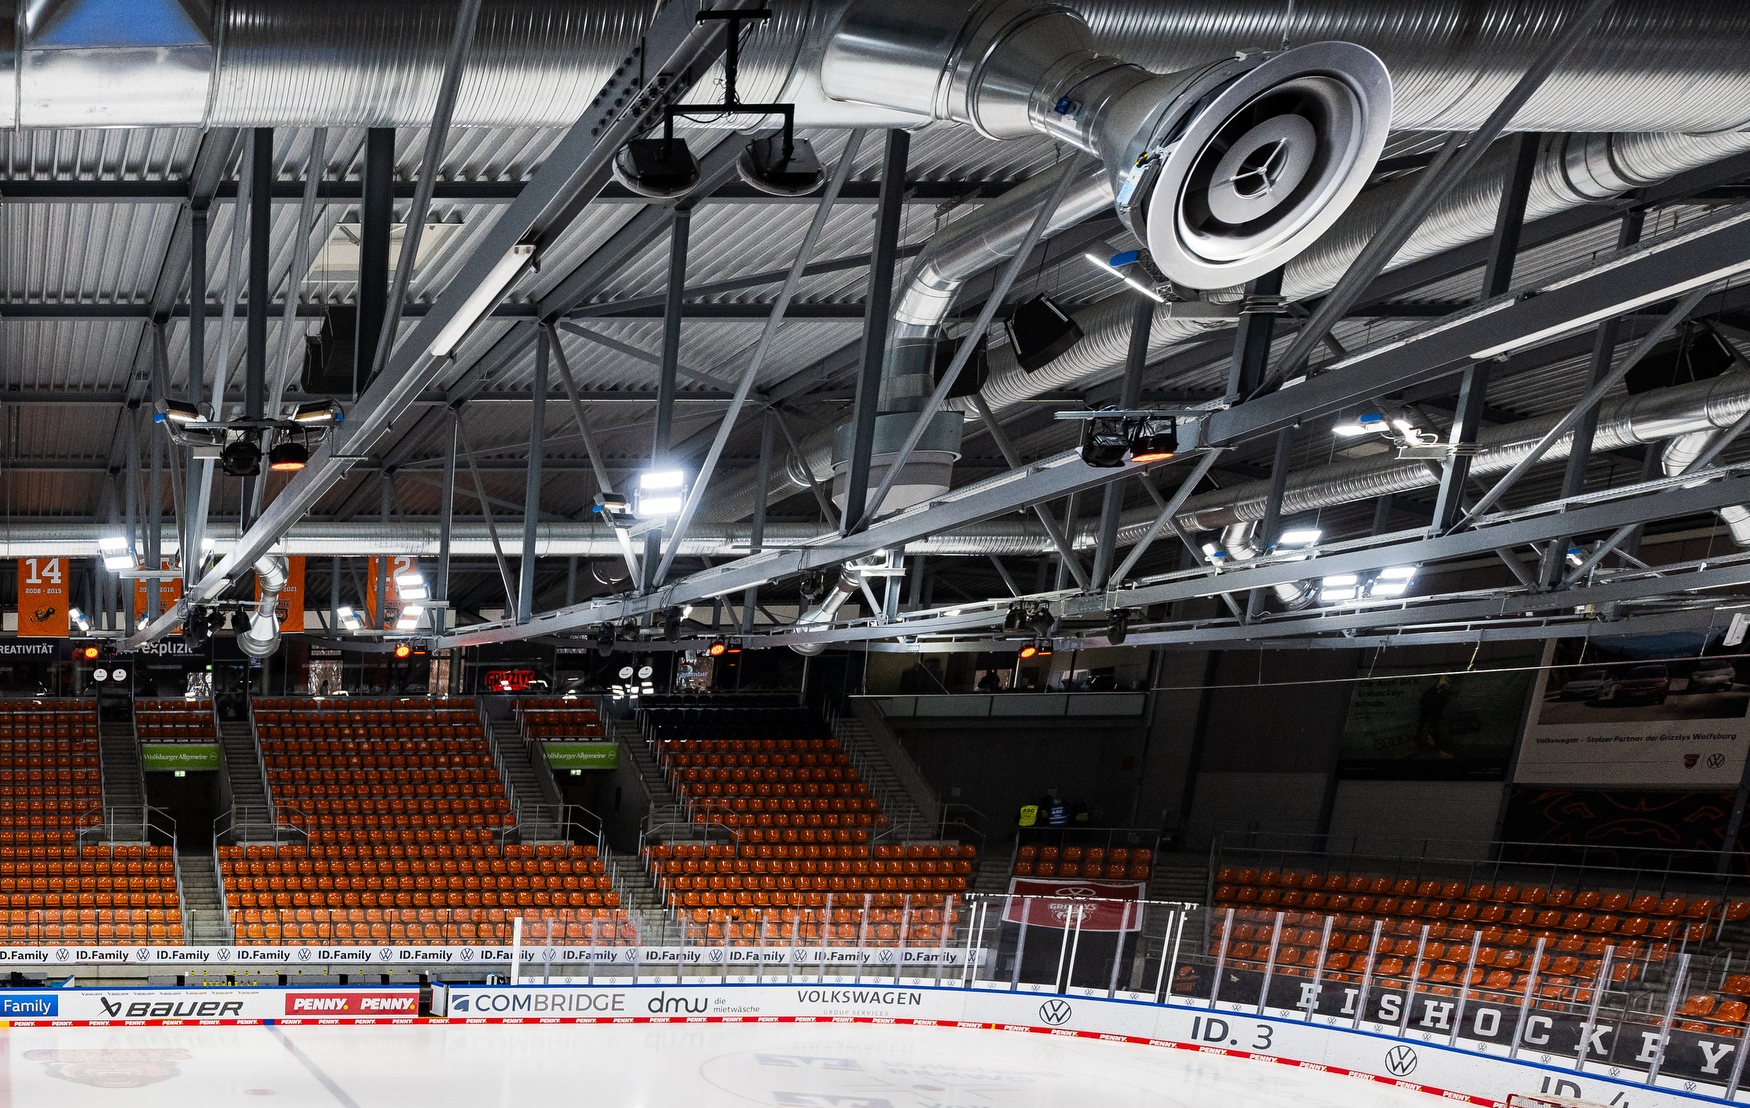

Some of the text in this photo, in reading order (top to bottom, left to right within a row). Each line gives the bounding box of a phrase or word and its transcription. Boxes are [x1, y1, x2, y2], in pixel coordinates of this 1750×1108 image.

[26, 559, 62, 584] 14
[1536, 737, 1579, 745] Volkswagen
[1586, 735, 1613, 743] Stolzer
[1614, 735, 1643, 743] Partner
[1659, 734, 1691, 742] Grizzlys
[1693, 732, 1737, 742] Wolfsburg
[76, 950, 129, 961] ID.Family
[237, 950, 290, 961] ID.Family
[318, 950, 371, 961] ID.Family
[563, 951, 617, 962] ID.Family
[646, 951, 701, 962] ID.Family
[475, 993, 625, 1012] COMBRIDGE
[648, 991, 708, 1013] dmw
[714, 997, 726, 1005] die
[797, 990, 922, 1006] VOLKSWAGEN
[4, 999, 51, 1015] Family
[713, 1005, 760, 1013] mietwäsche
[1191, 1016, 1274, 1050] ID. 3
